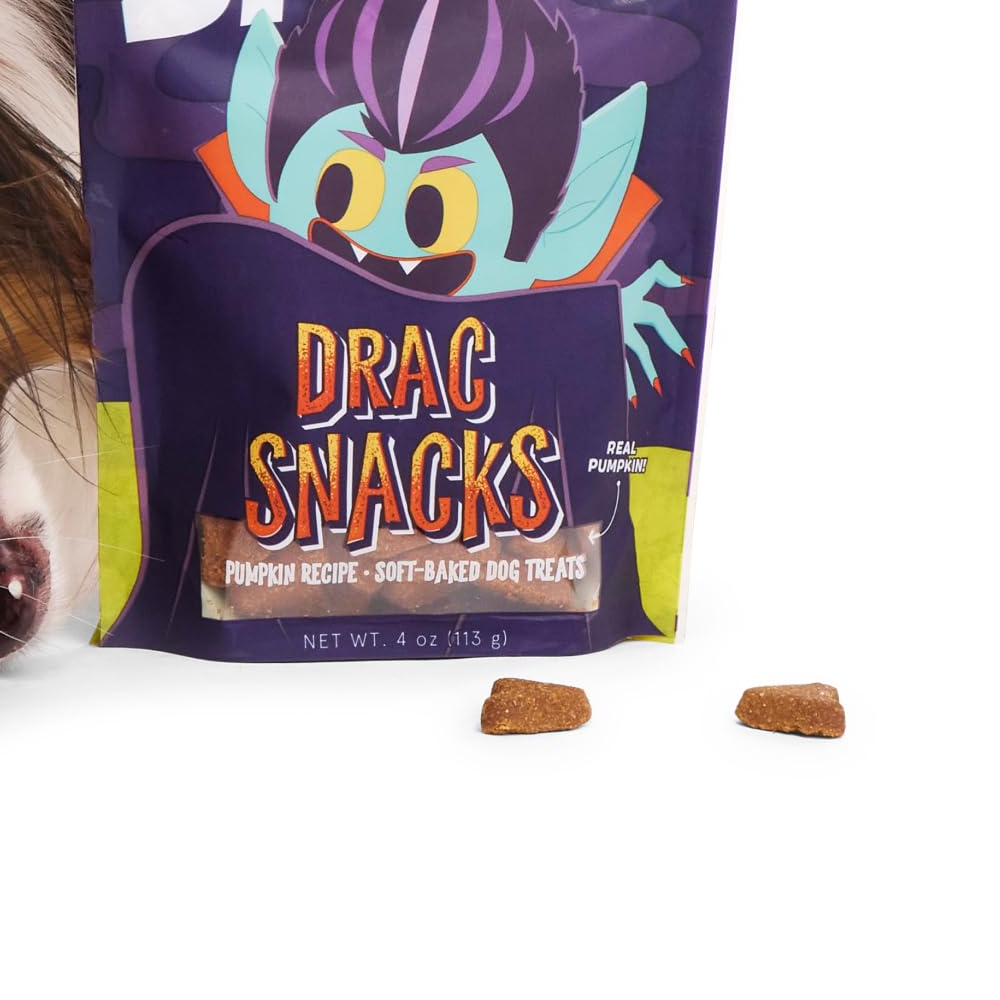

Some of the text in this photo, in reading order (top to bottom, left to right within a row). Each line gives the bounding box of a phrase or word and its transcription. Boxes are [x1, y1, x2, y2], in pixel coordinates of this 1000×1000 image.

[297, 317, 496, 429] DRAC
[606, 440, 637, 455] REAL
[587, 457, 648, 473] PUMPKIN!
[246, 425, 565, 556] SNACKS
[225, 555, 586, 587] PUMPKIN RECIPE SOFT-BAKED DOG TREATS
[303, 630, 508, 649] NET WT. 4 oz (113 g)
